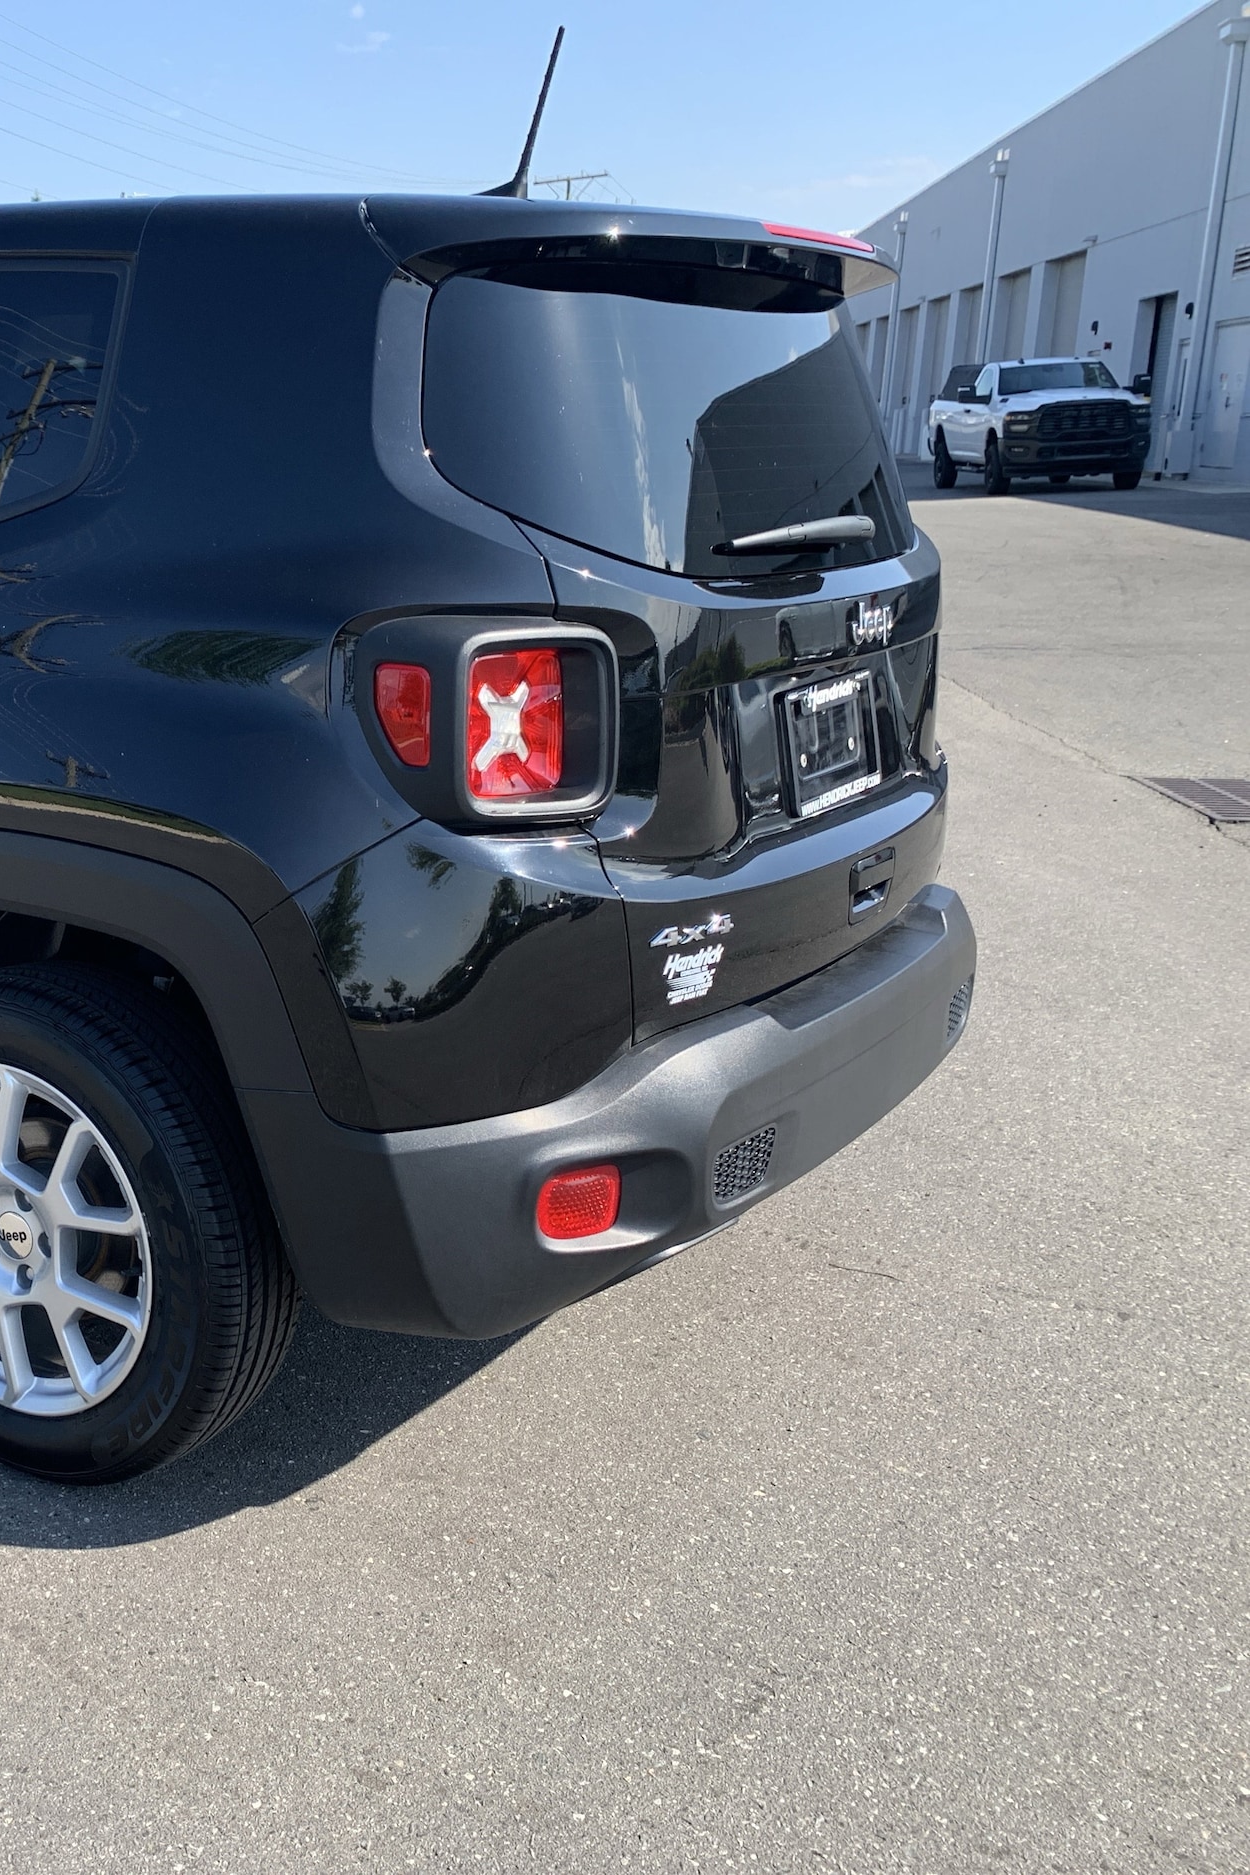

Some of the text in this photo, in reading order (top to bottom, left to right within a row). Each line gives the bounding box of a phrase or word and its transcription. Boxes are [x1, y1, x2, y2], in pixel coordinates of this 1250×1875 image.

[852, 601, 893, 647] Jeep
[662, 943, 725, 980] Hendrick
[0, 1229, 27, 1243] Jeep
